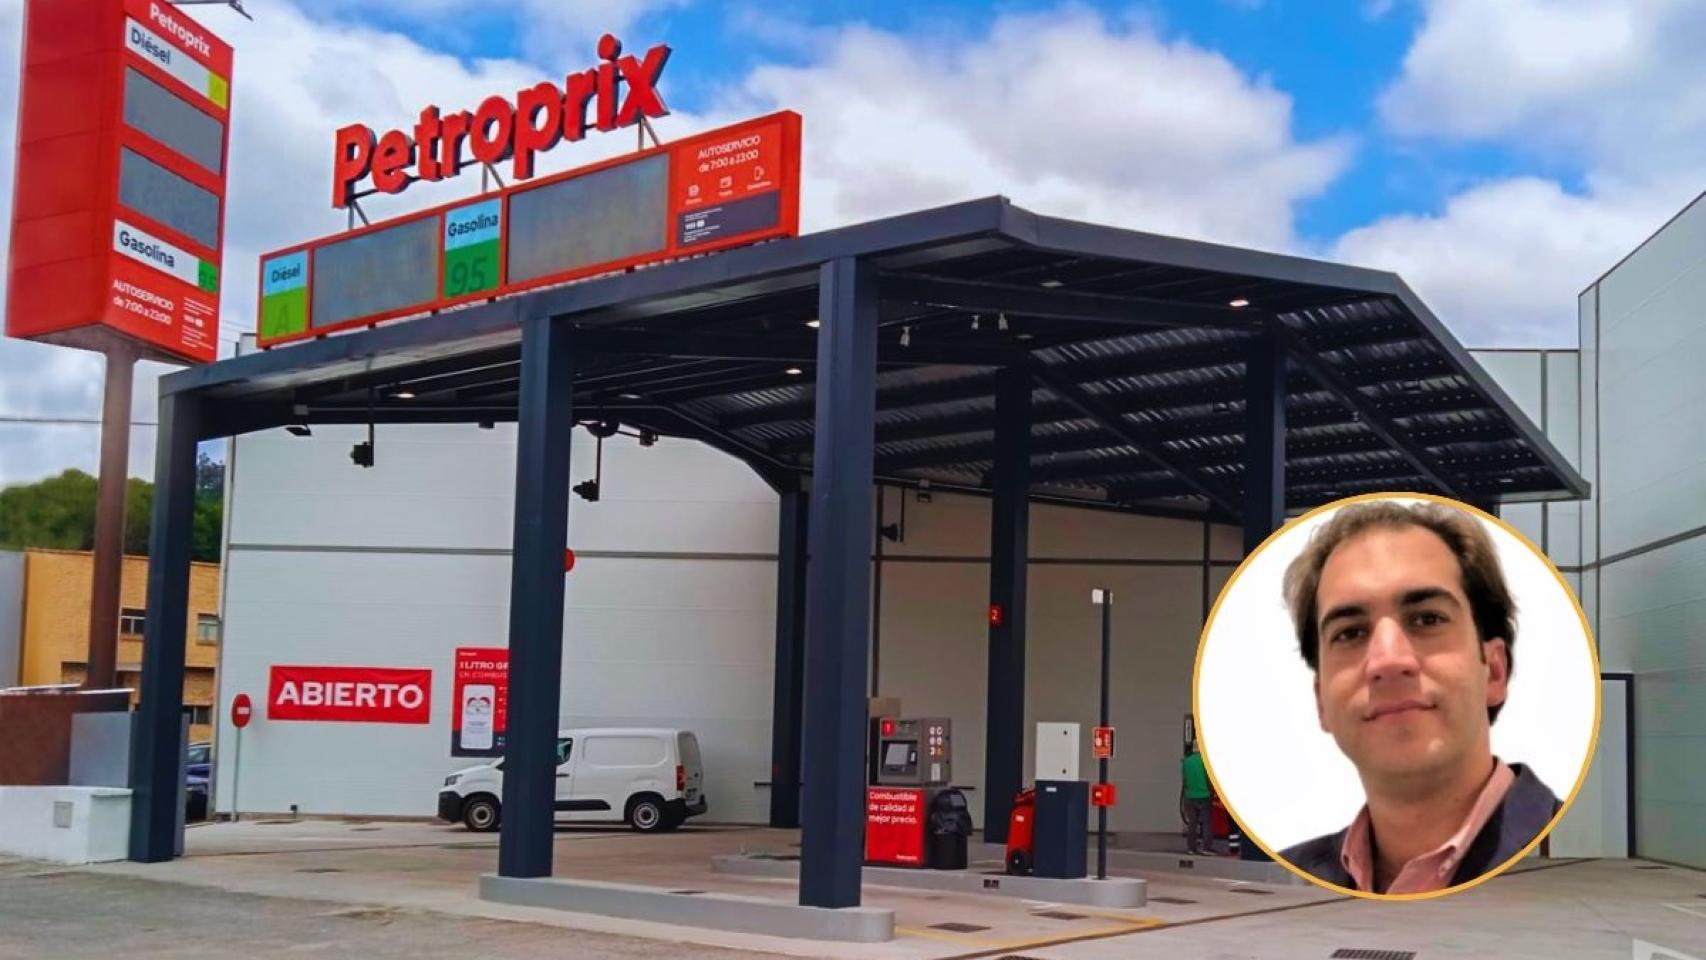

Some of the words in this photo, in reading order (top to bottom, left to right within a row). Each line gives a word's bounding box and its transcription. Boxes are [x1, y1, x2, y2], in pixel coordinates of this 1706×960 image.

[150, 2, 211, 57] Petroprix
[131, 27, 170, 64] Diésel
[333, 34, 671, 208] Petroprix
[697, 135, 760, 160] AUTOSERVICIO
[699, 162, 710, 173] de
[710, 157, 729, 171] 7:00
[448, 213, 498, 237] Gasolina
[120, 231, 175, 268] Gasolina
[272, 262, 301, 283] Diésel
[452, 256, 488, 296] 95
[113, 280, 174, 310] AUTOSERVICIO
[113, 296, 124, 307] de
[465, 662, 494, 670] LITRO
[276, 681, 424, 709] ABIERTO
[869, 803, 878, 811] de
[880, 803, 907, 812] calidad
[908, 804, 915, 812] al
[870, 792, 918, 800] Combustible
[869, 814, 890, 824] mejor
